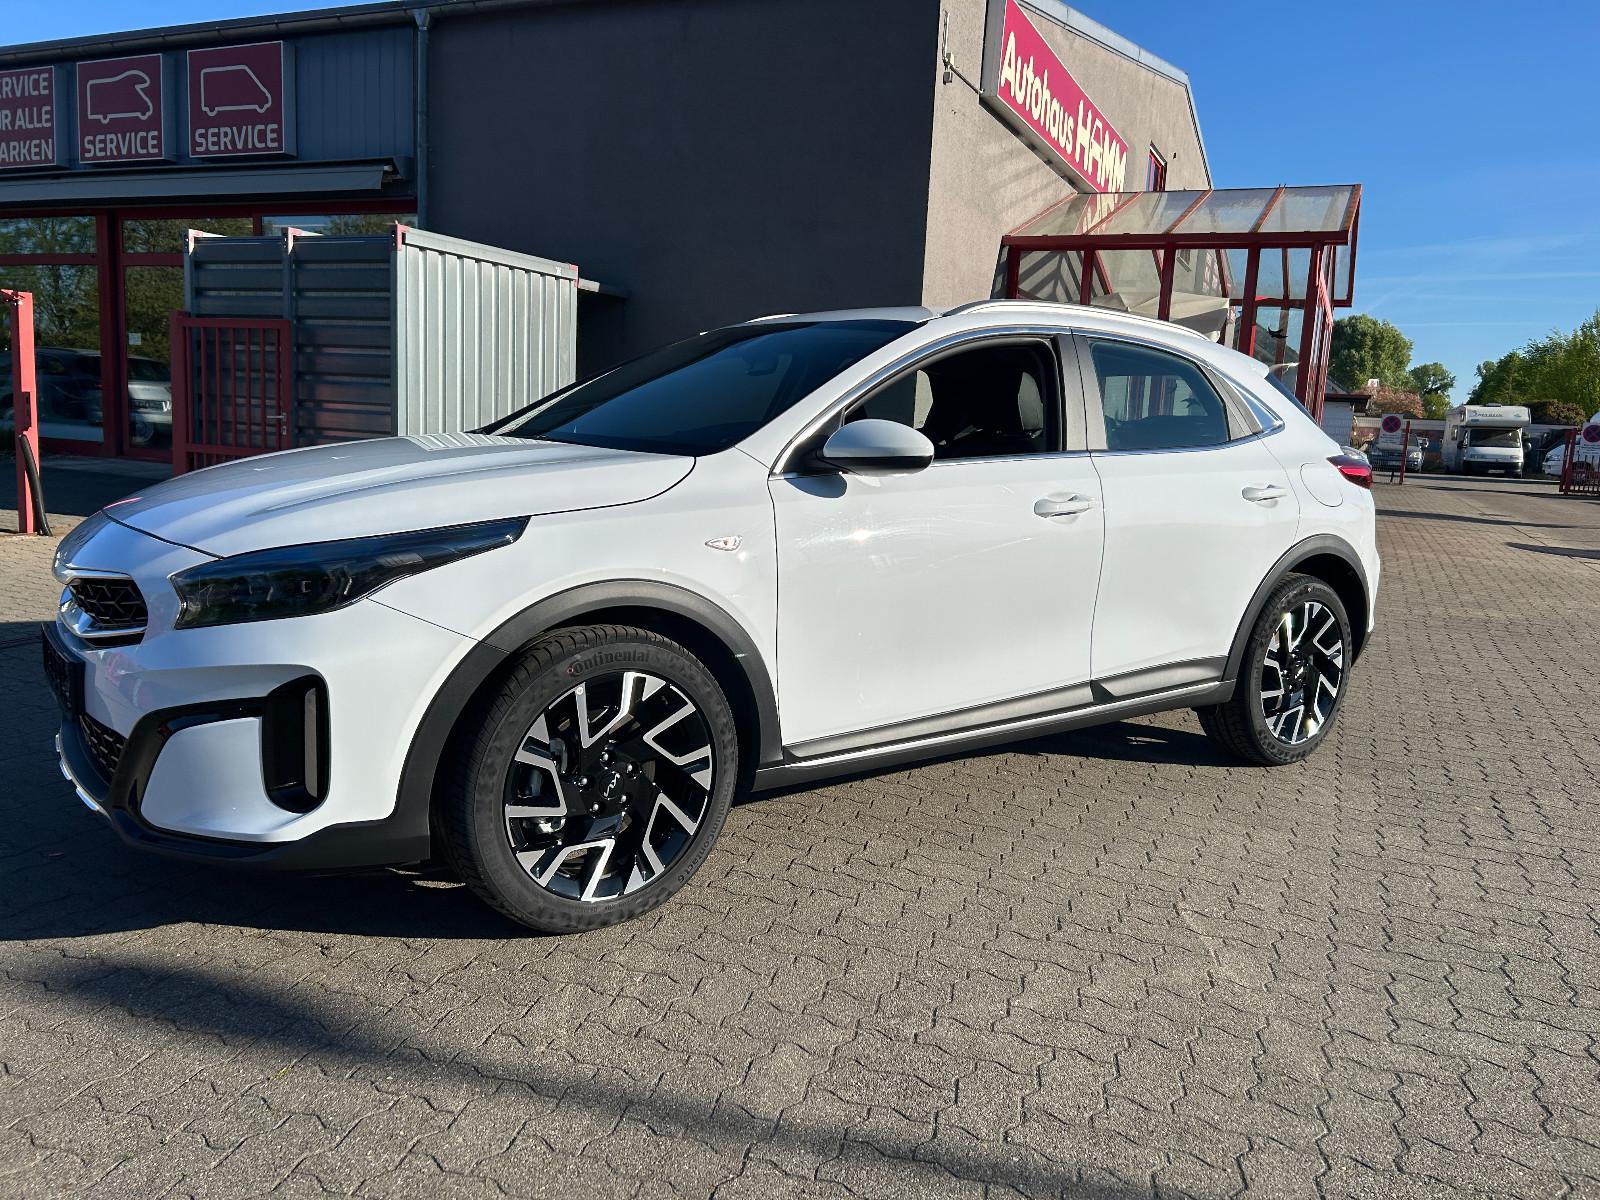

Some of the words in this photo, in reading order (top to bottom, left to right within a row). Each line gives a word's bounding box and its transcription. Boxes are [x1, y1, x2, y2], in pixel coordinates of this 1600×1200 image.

[0, 73, 49, 98] RVICE
[1001, 31, 1074, 154] Autohaus
[15, 106, 51, 129] ALLE
[84, 131, 158, 158] SERVICE
[195, 124, 278, 152] SERVICE
[568, 648, 649, 677] Continental
